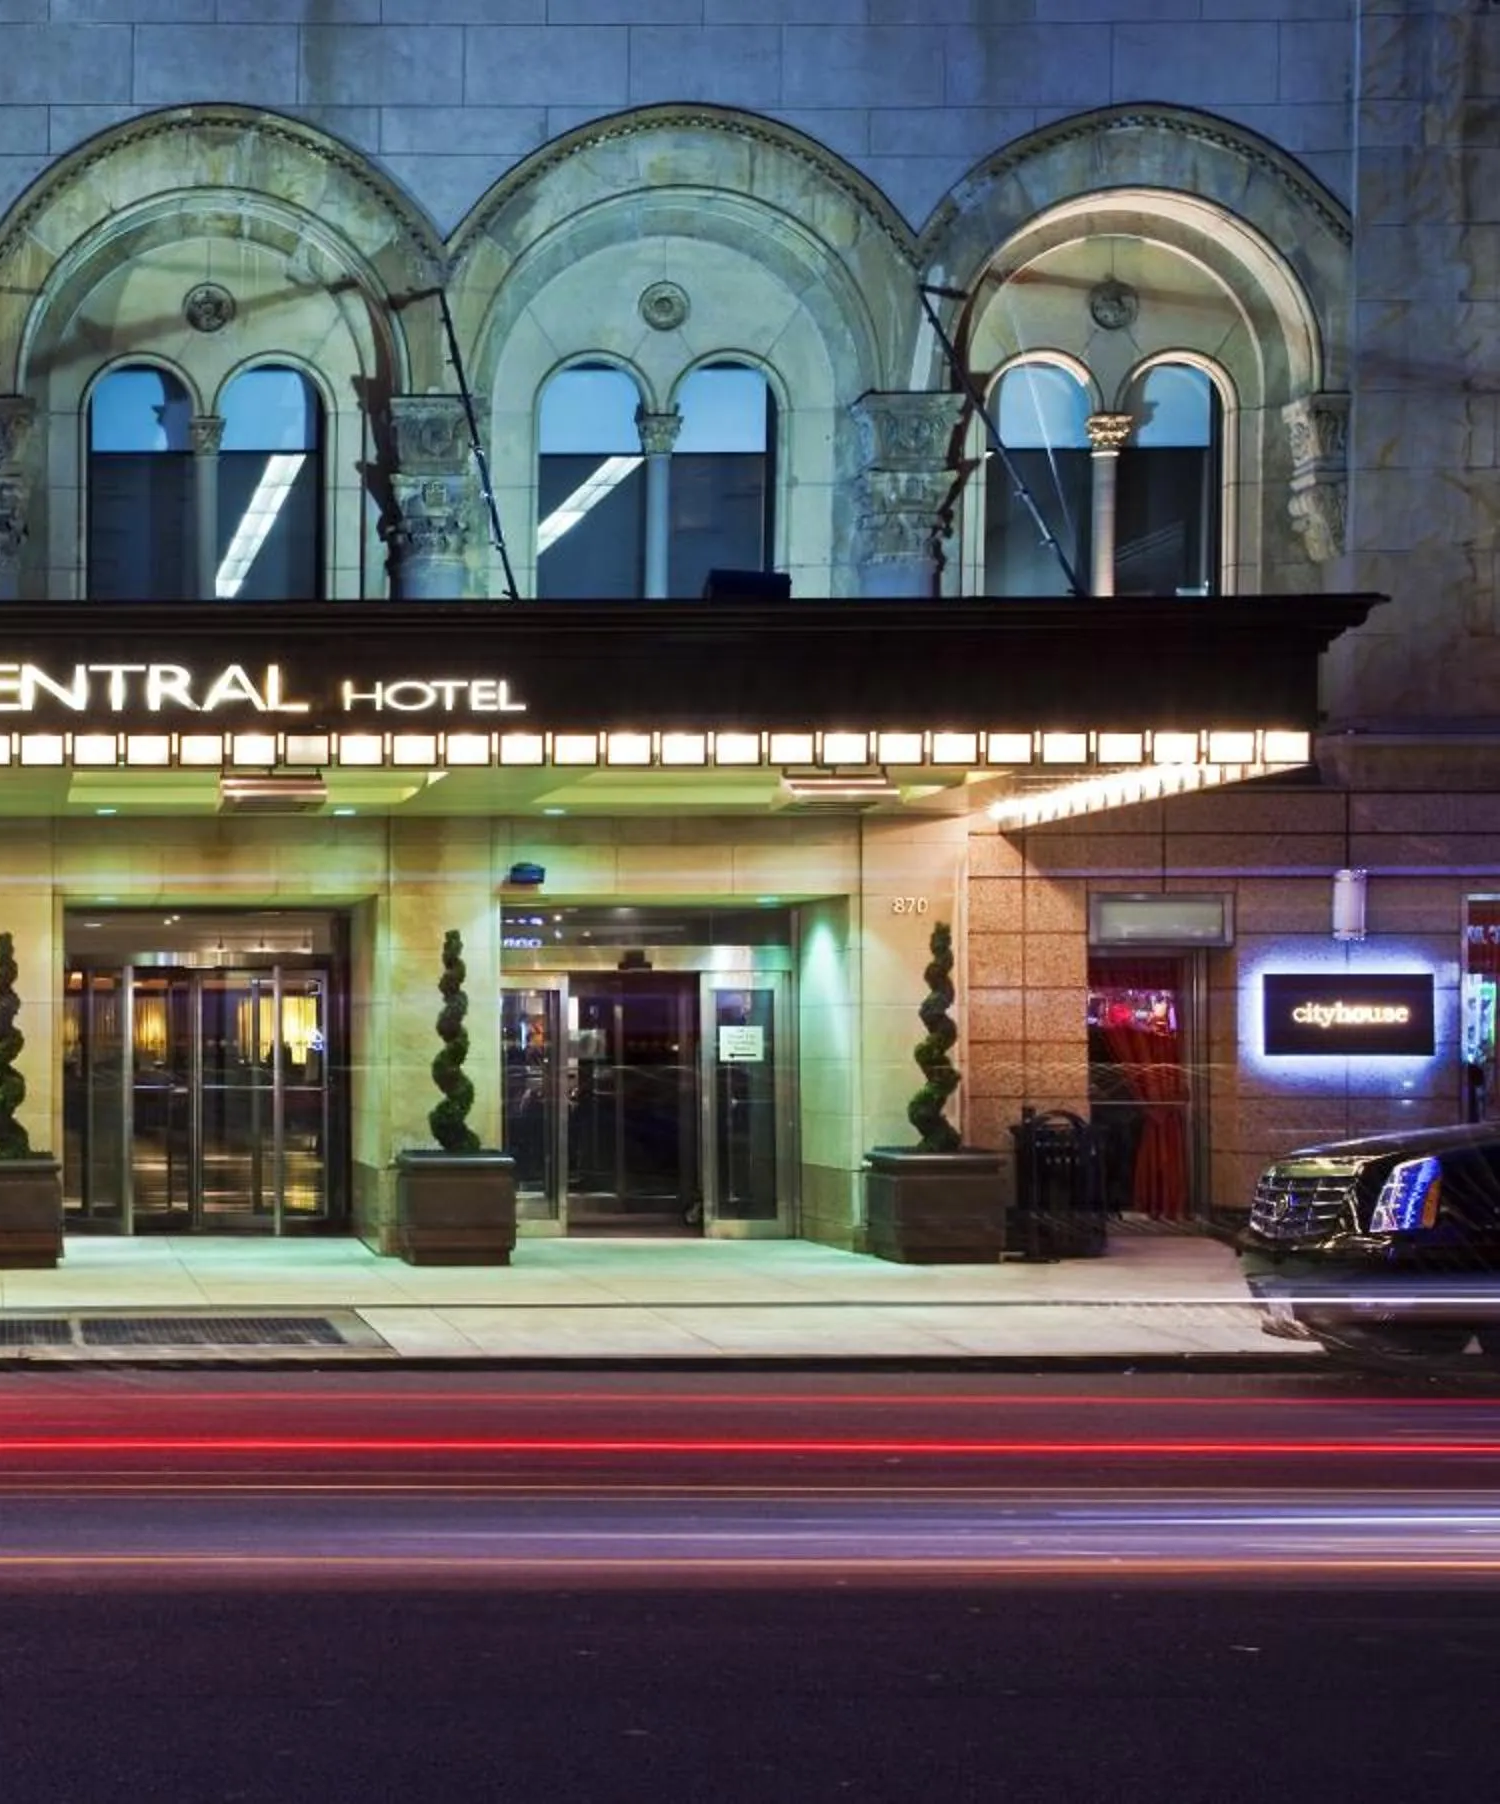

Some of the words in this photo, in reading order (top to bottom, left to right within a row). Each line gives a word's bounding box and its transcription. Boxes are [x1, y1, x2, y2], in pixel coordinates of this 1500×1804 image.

[340, 678, 527, 712] HOTEL
[893, 896, 929, 914] 870
[1291, 1000, 1410, 1029] cityhouse
